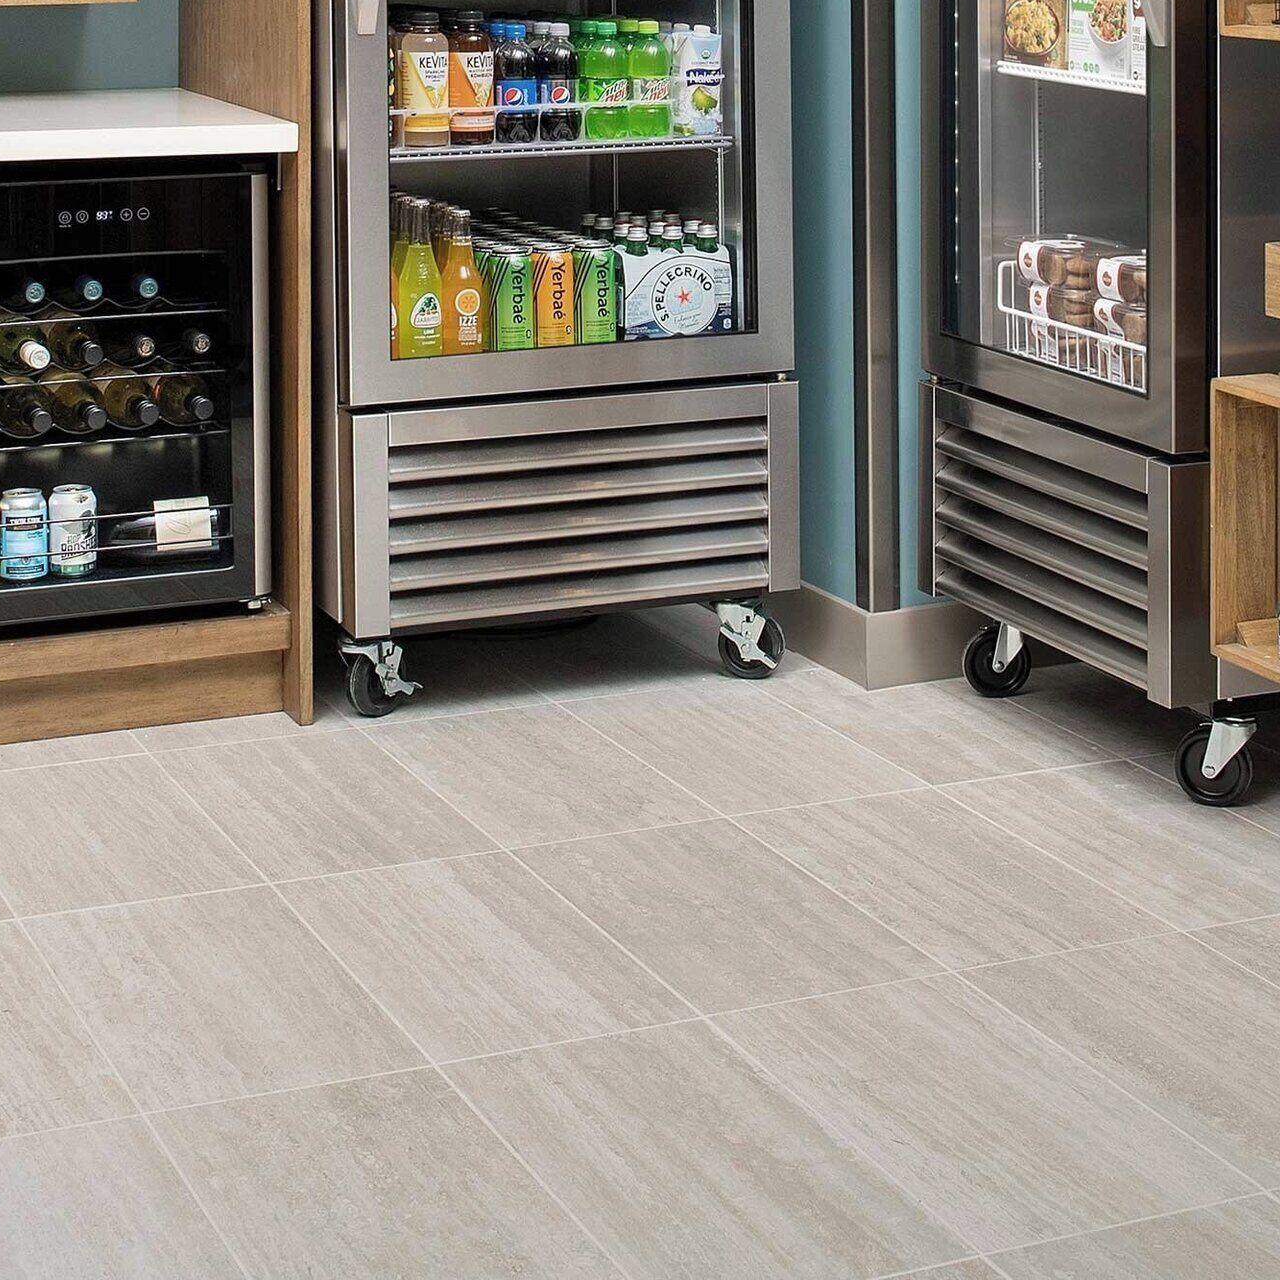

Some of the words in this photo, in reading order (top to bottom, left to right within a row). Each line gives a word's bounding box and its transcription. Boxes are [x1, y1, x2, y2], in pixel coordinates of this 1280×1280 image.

[510, 265, 527, 324] Yerbaé
[551, 261, 567, 320] Yerbaé
[596, 260, 611, 318] Yerbaé
[458, 315, 478, 327] IZZE
